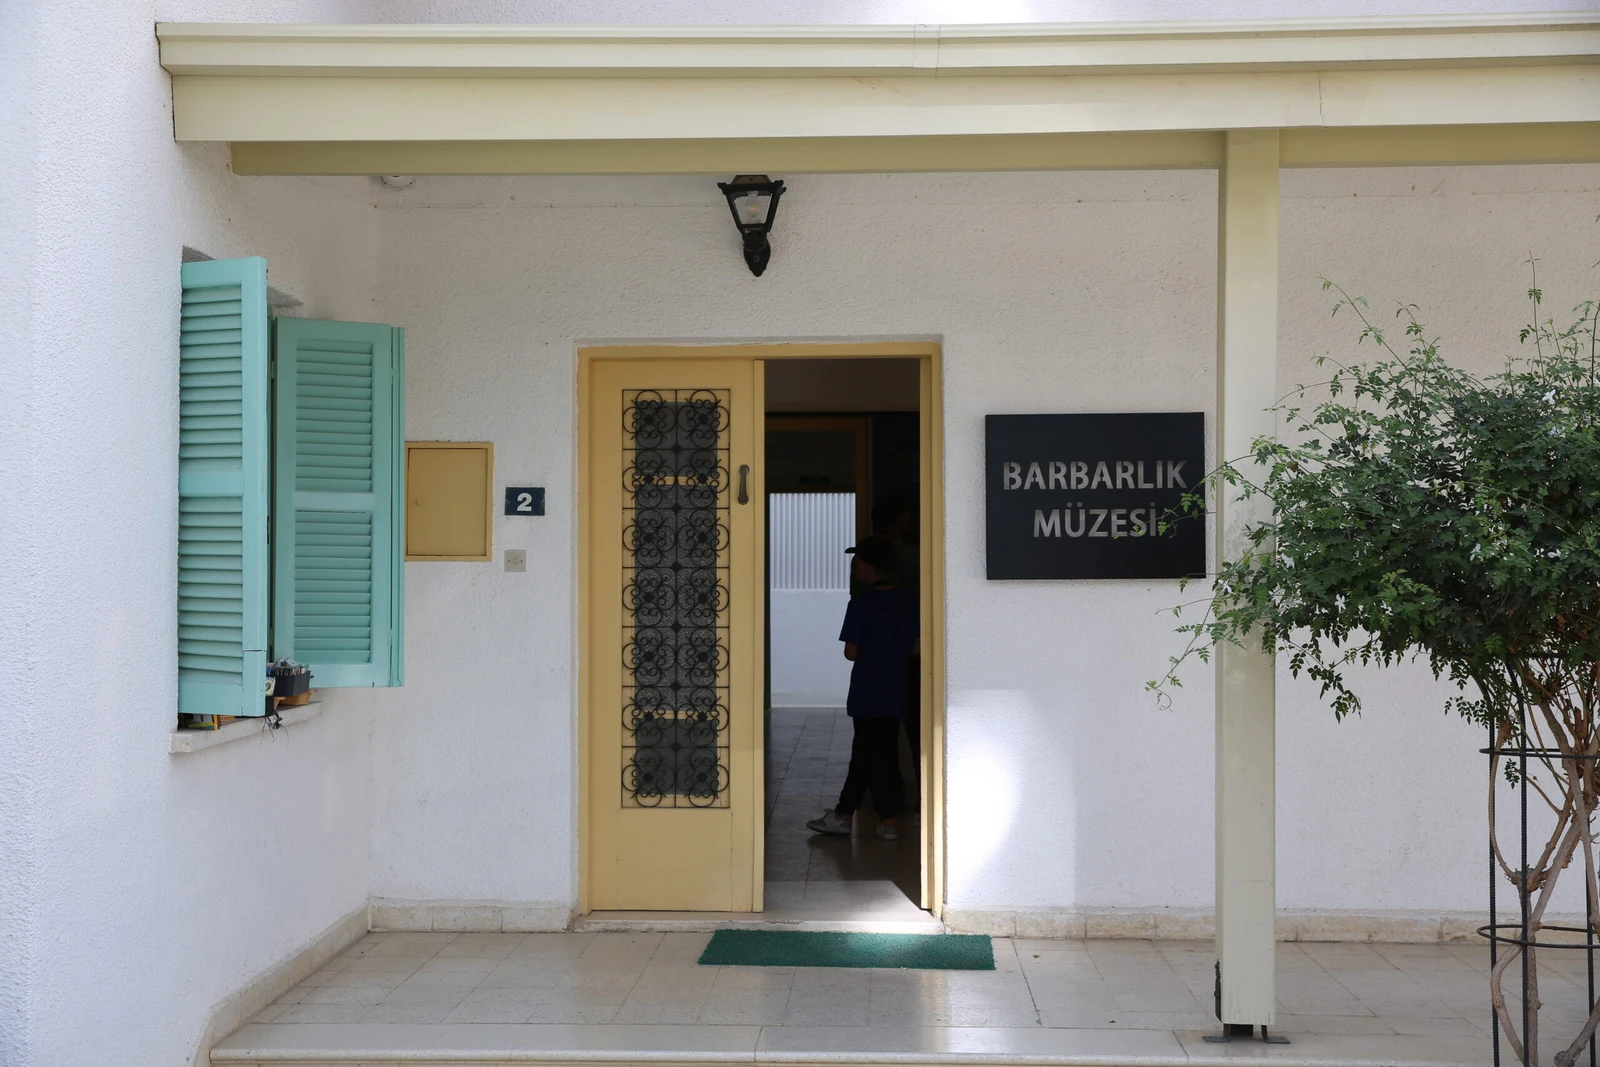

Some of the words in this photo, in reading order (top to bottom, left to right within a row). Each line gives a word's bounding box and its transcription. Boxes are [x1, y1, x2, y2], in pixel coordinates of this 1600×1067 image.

[1003, 460, 1188, 490] BARBARLIK
[516, 492, 533, 512] 2
[1033, 501, 1157, 538] MÜZESİ
